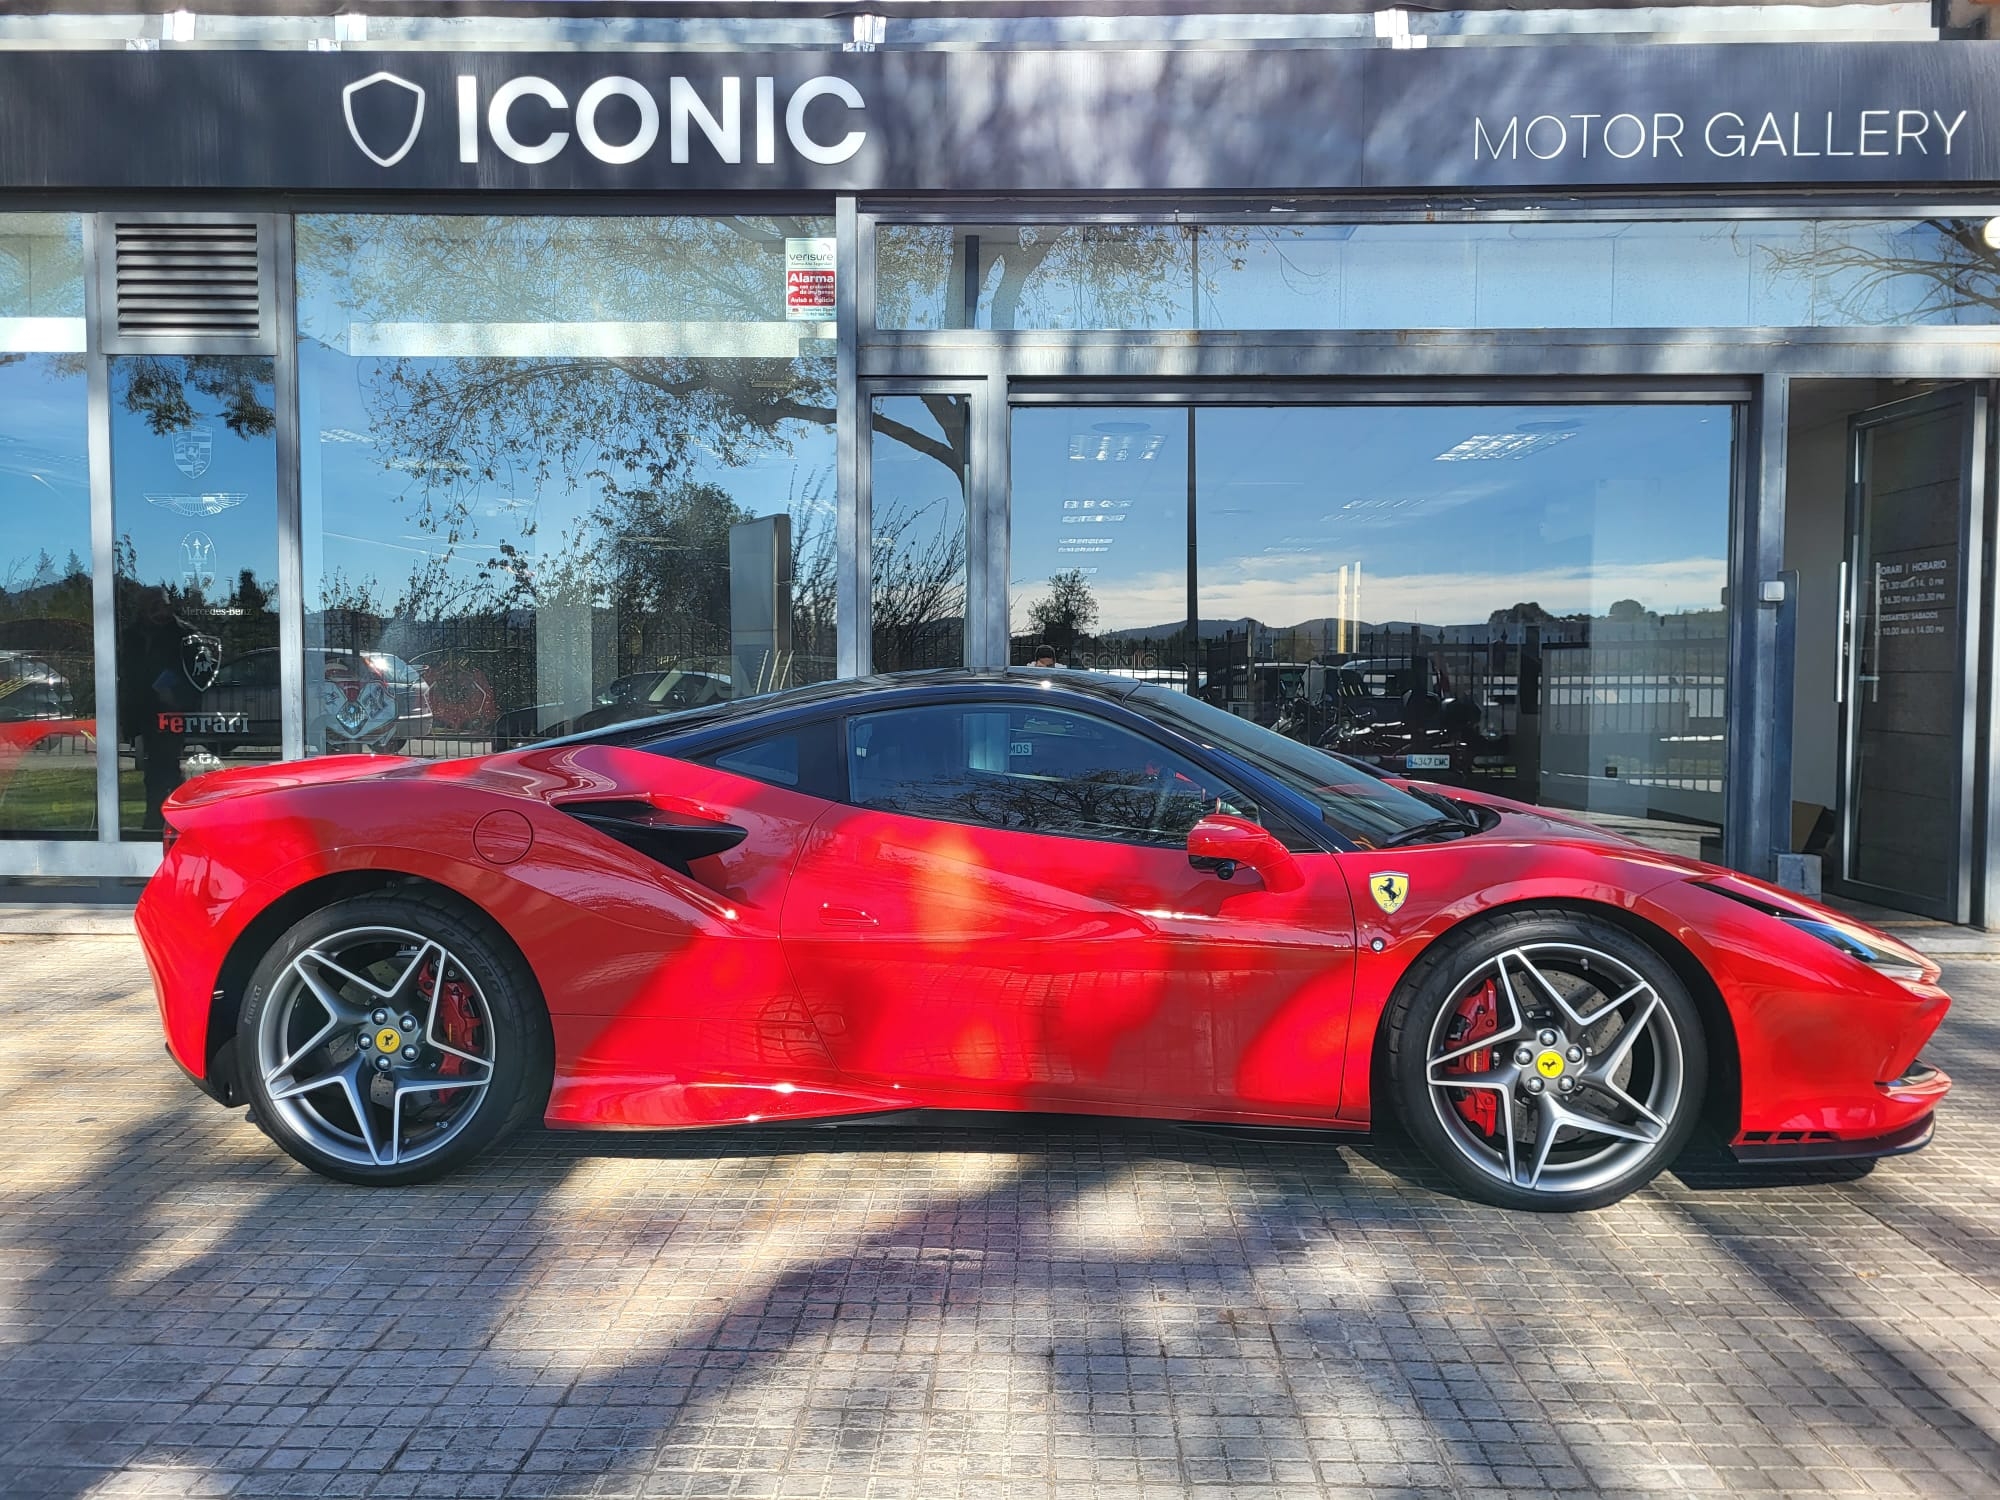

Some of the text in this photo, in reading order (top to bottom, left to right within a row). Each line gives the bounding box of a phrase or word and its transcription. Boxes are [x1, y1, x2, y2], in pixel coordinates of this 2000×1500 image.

[458, 75, 866, 165] ICONIC
[1474, 109, 1967, 161] MOTOR GALLERY
[789, 253, 834, 261] verisure
[789, 272, 834, 283] Alarma
[1878, 560, 1947, 575] ORARI HORARIO
[1915, 578, 1934, 588] 14.0
[181, 606, 252, 616] Mercedes-Benz
[156, 711, 249, 734] Ferrari
